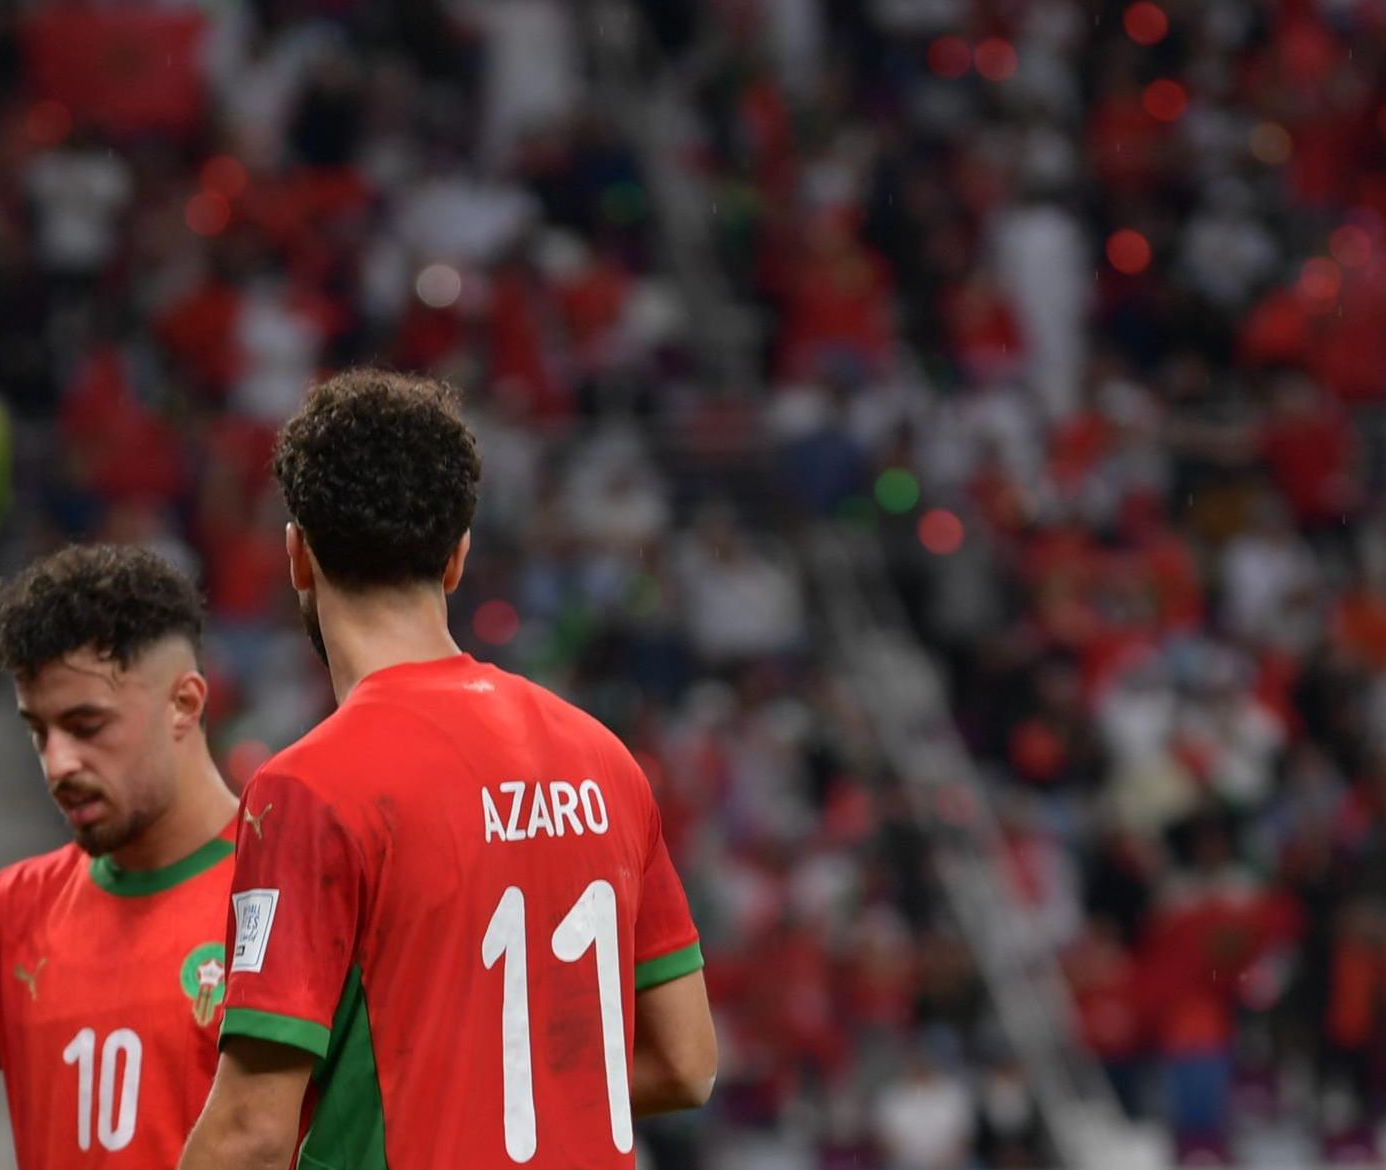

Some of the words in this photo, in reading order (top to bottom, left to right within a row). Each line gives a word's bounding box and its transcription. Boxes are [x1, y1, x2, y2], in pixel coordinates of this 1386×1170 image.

[482, 779, 609, 843] AZARO
[481, 879, 633, 1163] 11
[63, 1027, 143, 1151] 10
